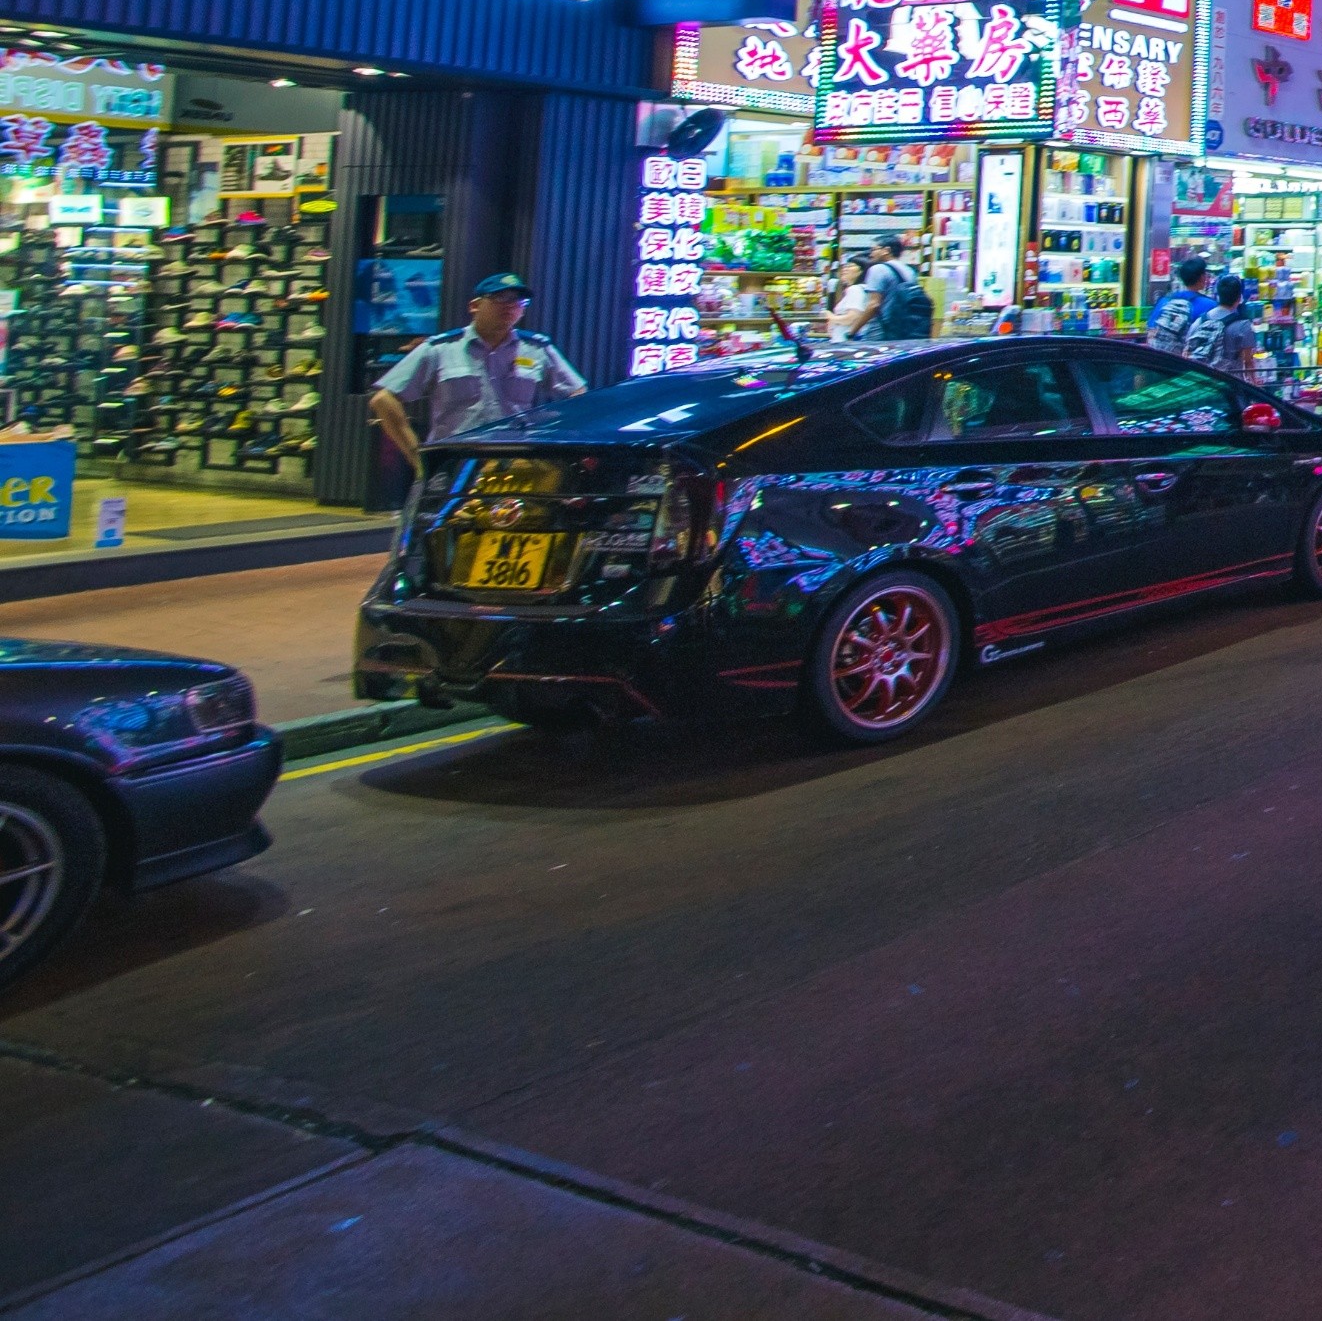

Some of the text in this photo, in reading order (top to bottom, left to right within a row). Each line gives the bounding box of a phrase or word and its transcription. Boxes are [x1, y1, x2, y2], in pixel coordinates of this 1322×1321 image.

[833, 4, 1031, 85] 大藥房
[478, 559, 531, 586] 3816
